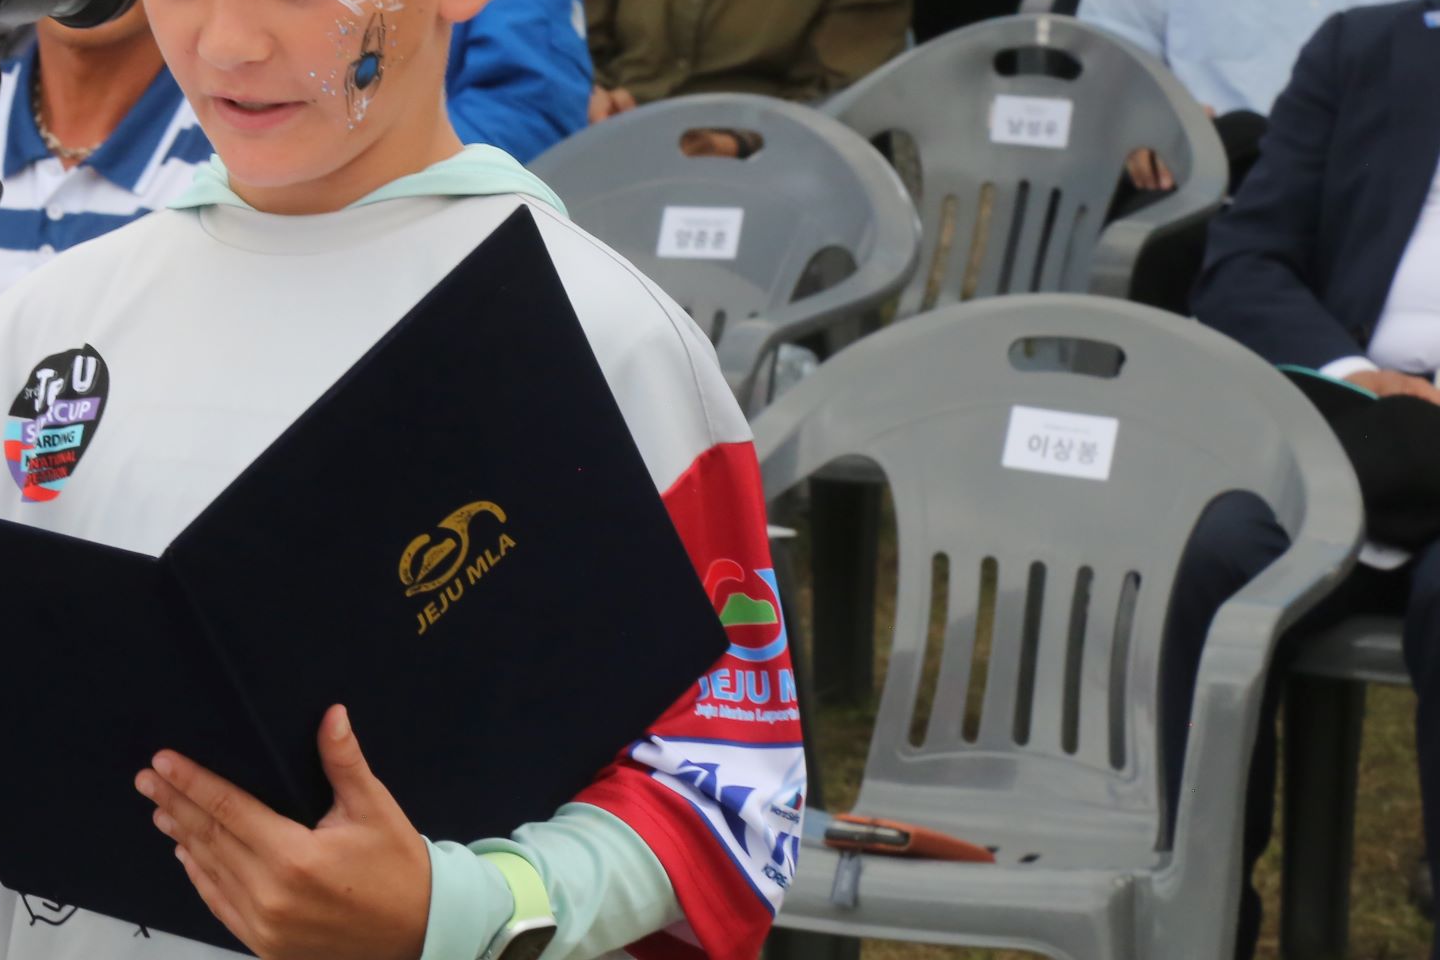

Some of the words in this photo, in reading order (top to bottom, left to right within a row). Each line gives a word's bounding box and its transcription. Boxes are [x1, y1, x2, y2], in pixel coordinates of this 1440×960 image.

[417, 577, 464, 635] JEJU
[465, 532, 517, 586] MLA
[696, 668, 772, 705] JEJU
